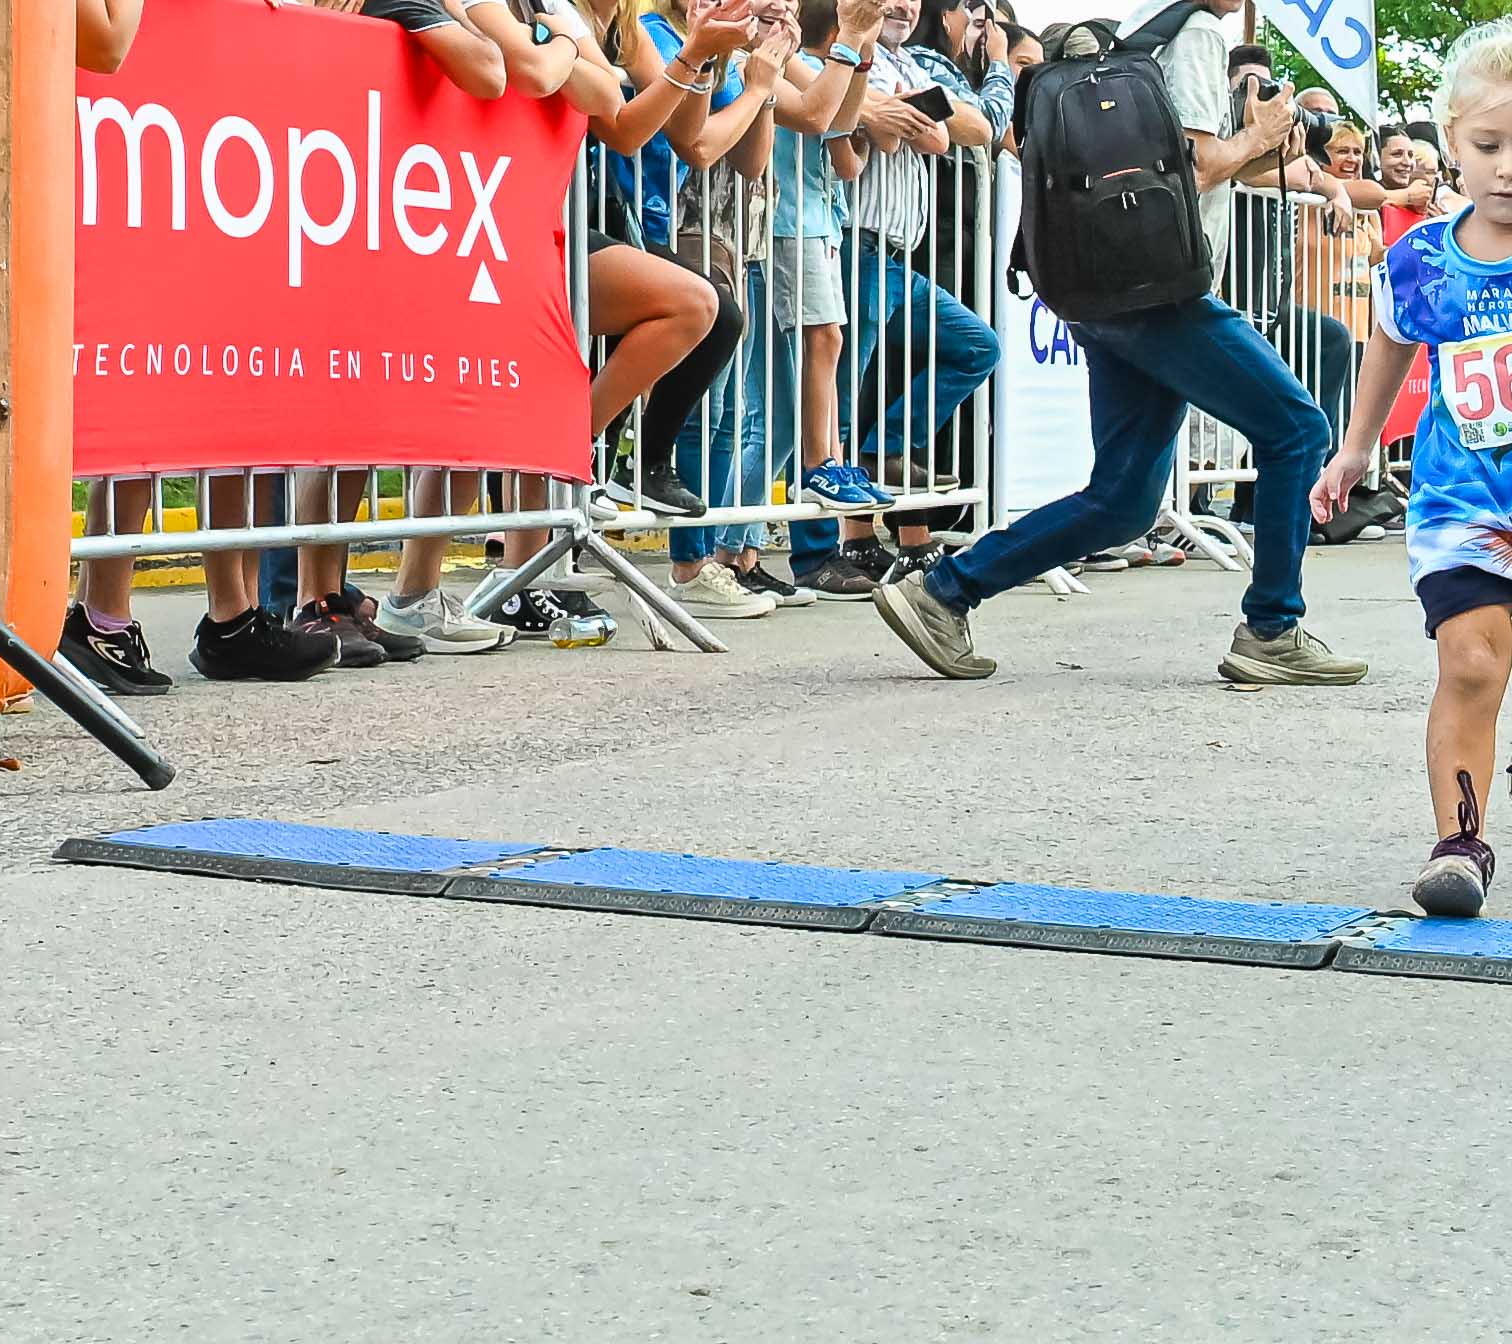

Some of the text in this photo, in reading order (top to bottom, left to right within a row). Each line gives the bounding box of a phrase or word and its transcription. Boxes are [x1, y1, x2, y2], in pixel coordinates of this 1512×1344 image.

[76, 89, 513, 288] moplex
[71, 342, 521, 388] TECNOLOGIA EN TUS PIES
[809, 474, 840, 495] FILA
